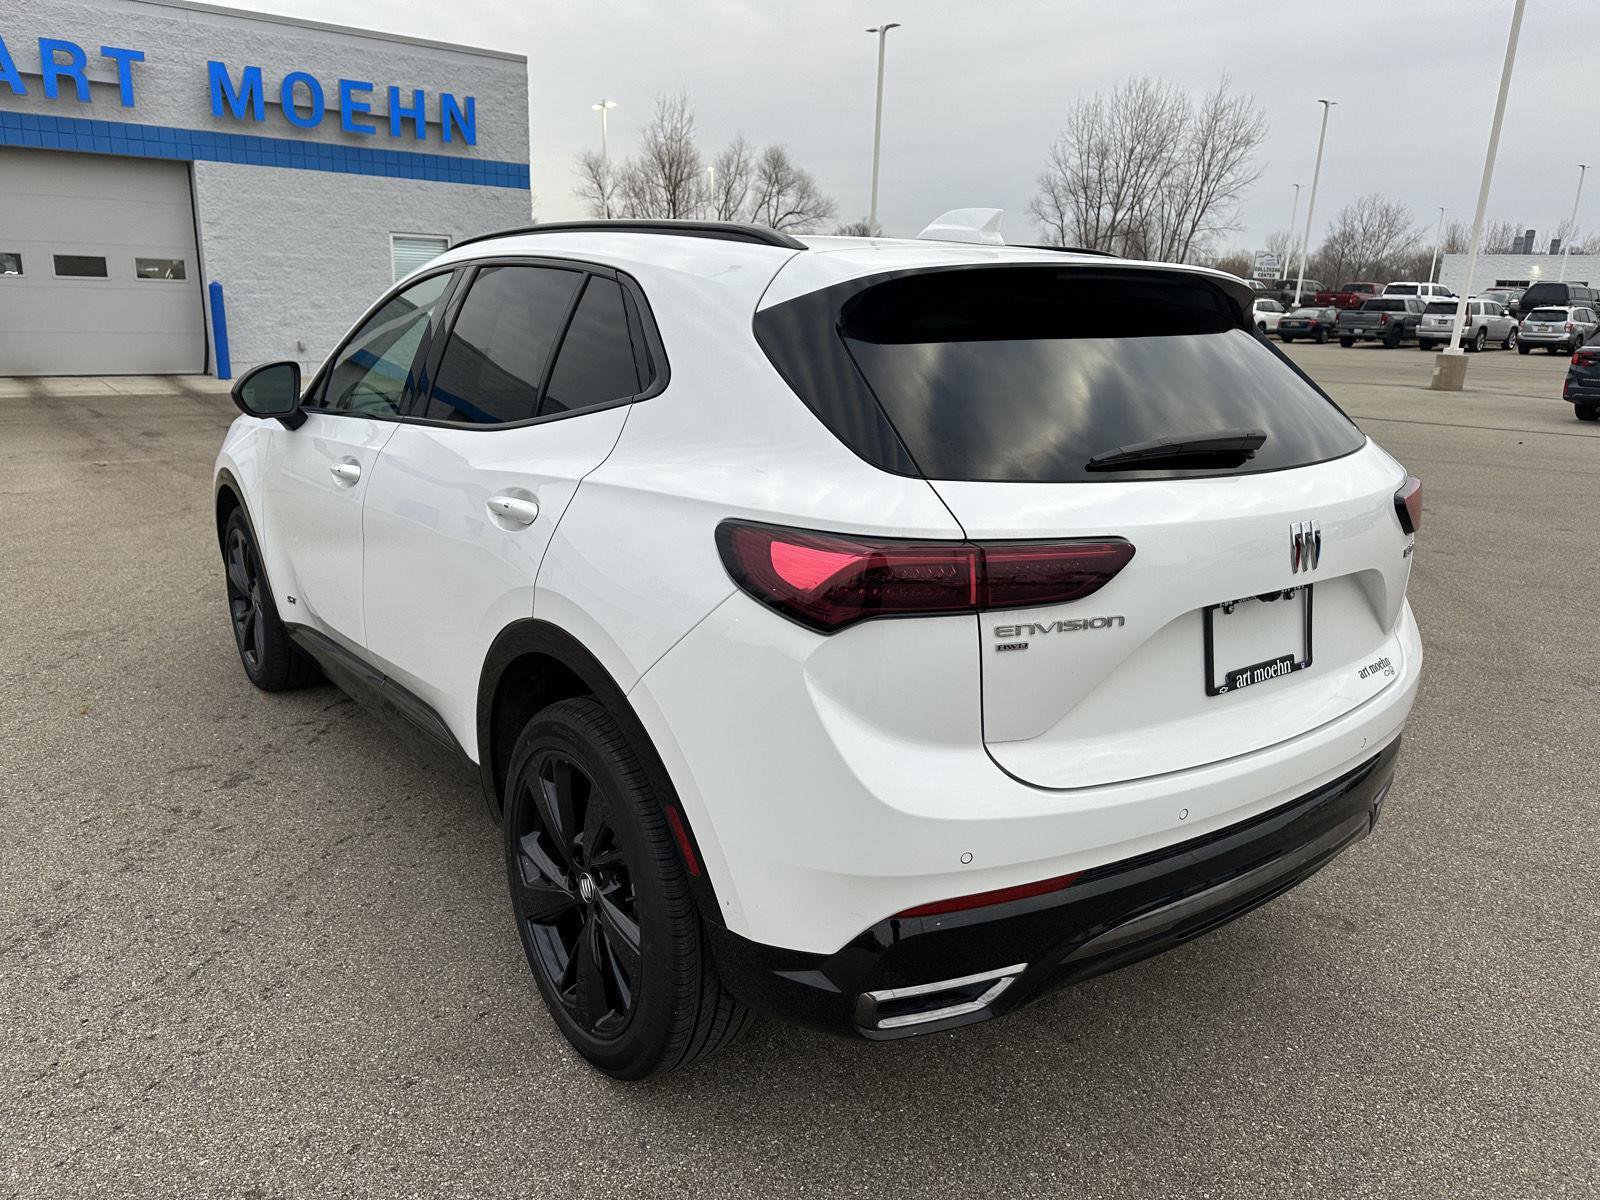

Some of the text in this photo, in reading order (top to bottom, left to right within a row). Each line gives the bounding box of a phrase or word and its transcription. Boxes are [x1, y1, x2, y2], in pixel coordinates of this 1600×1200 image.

[207, 60, 477, 146] MOEHN
[994, 615, 1126, 638] ENVISION
[996, 642, 1029, 652] AWD
[1236, 659, 1292, 689] art moehn
[1358, 657, 1391, 679] art moehn
